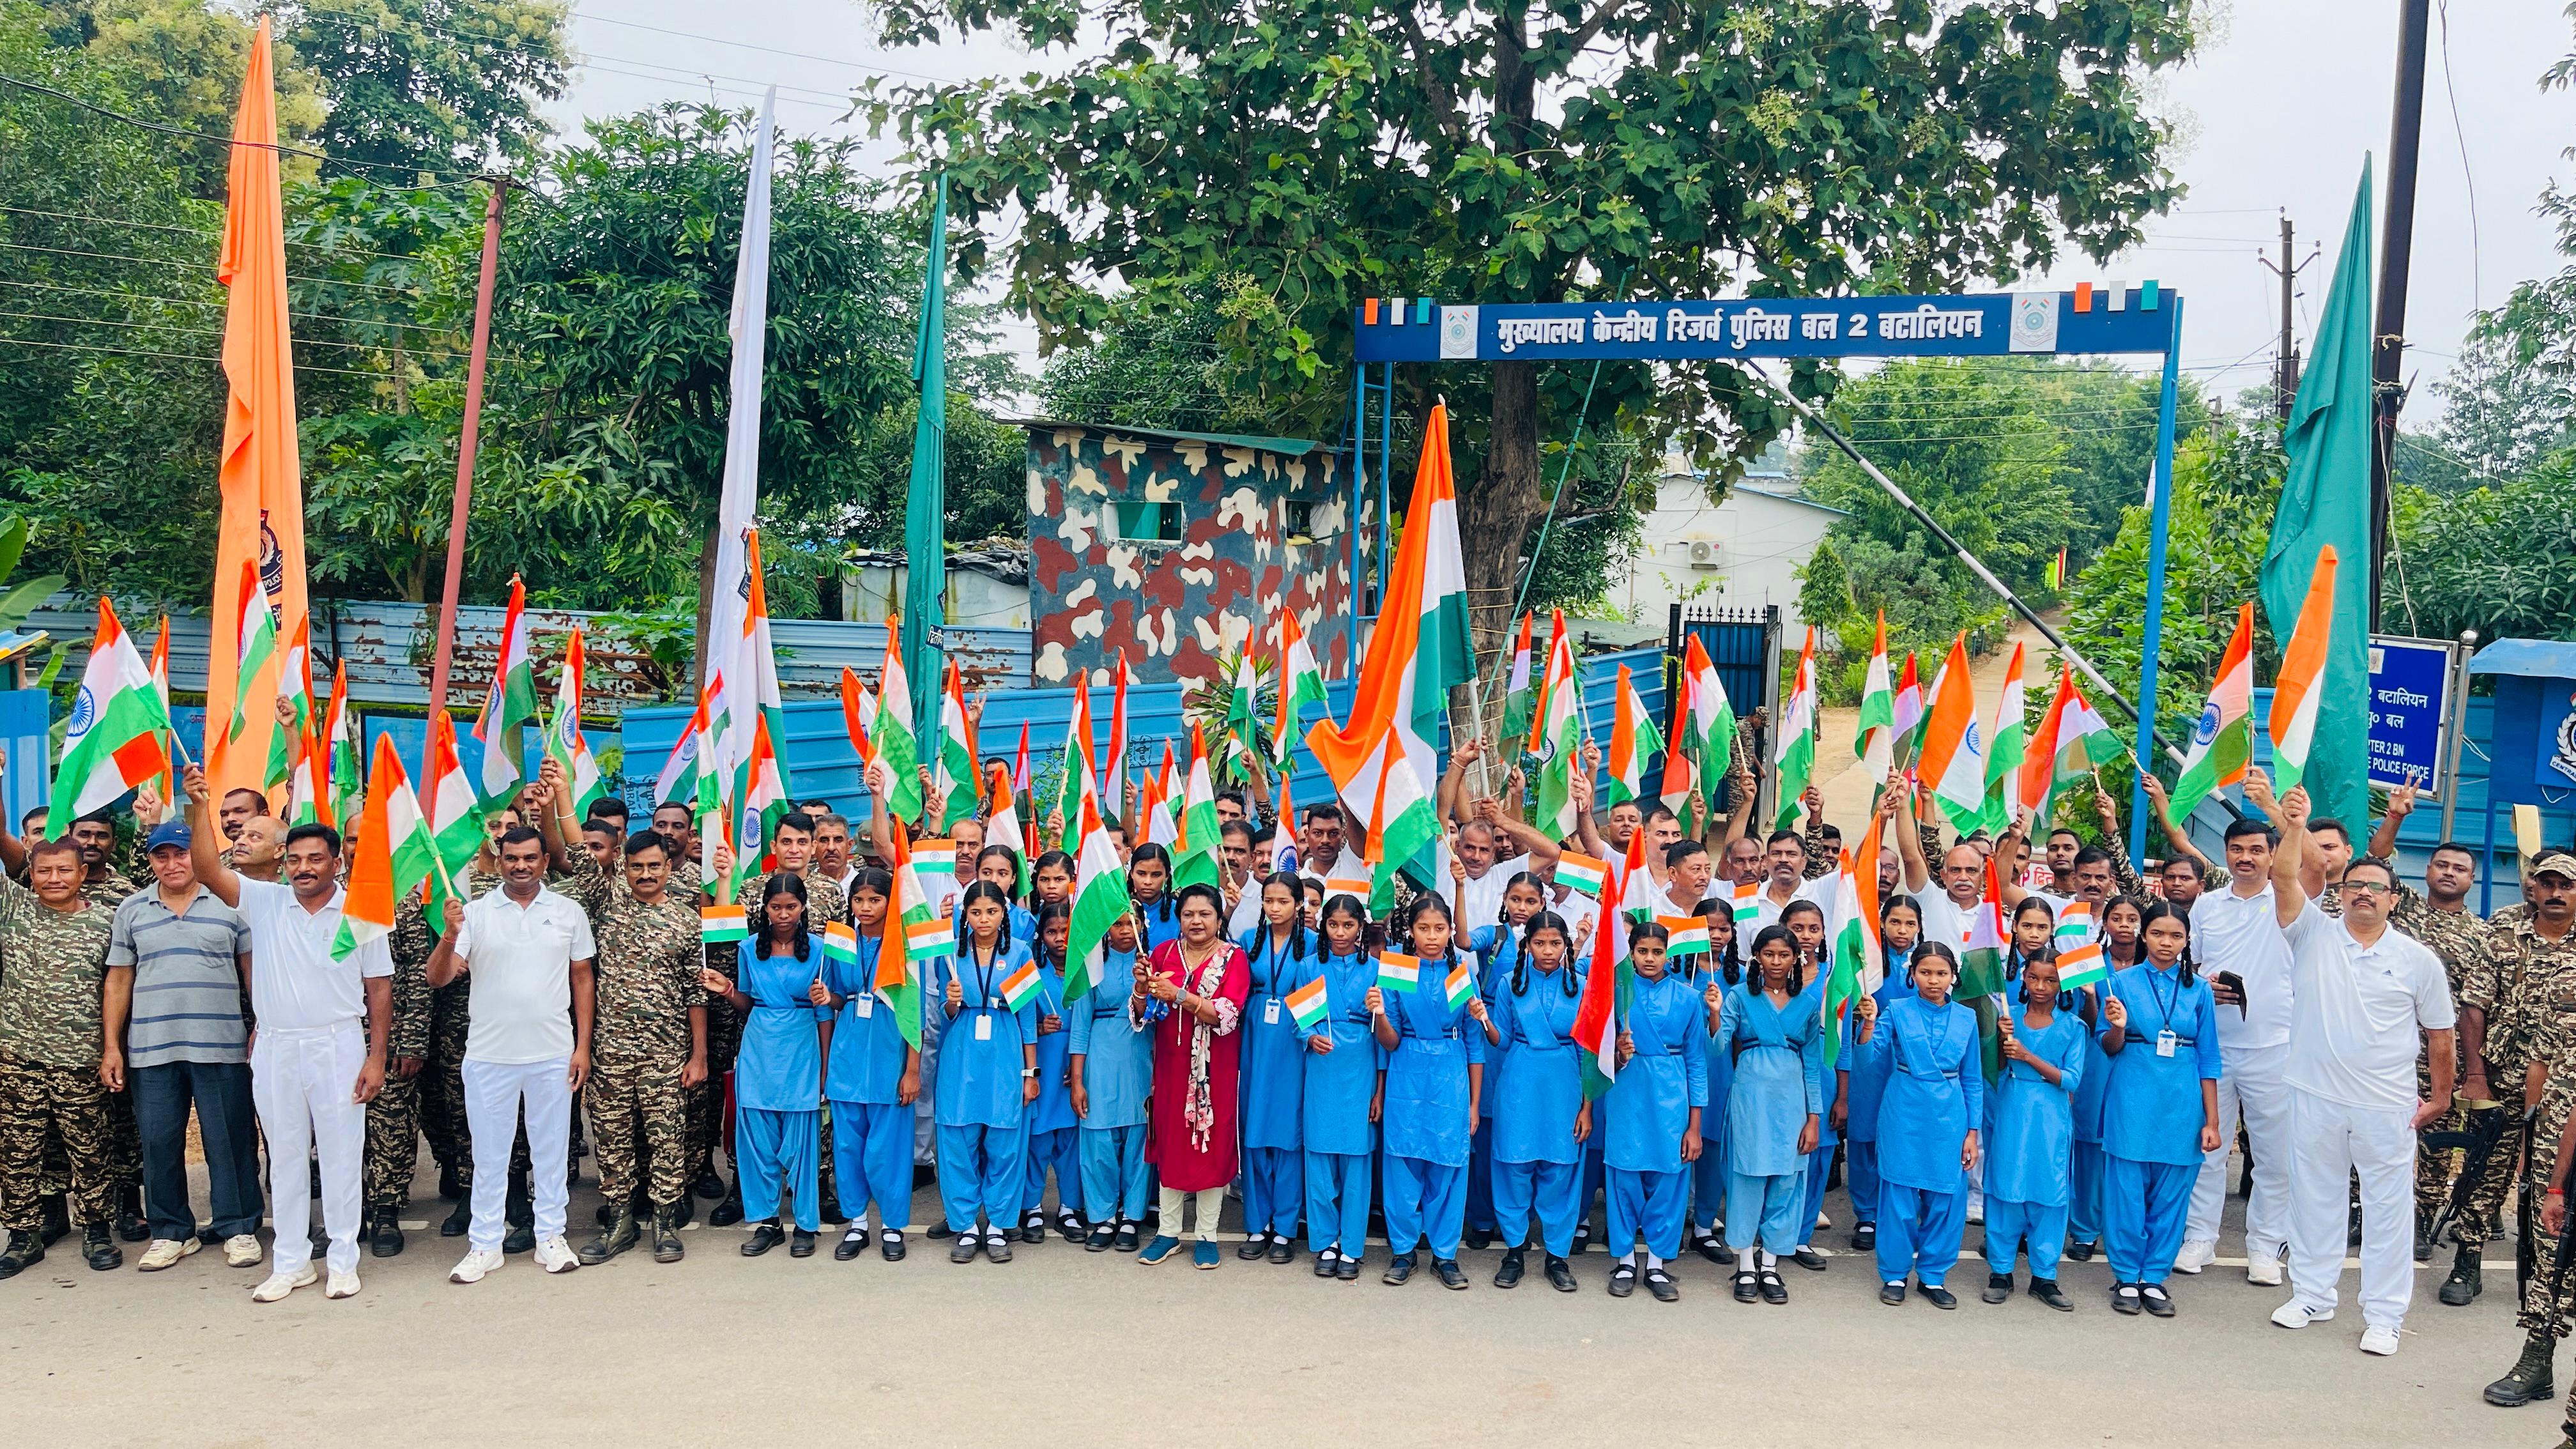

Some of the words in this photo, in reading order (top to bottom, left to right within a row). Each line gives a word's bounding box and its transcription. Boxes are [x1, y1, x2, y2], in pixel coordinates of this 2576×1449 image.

[1498, 318, 1586, 353] मुख्यालय
[1592, 309, 1659, 344] केन्द्रीय
[1666, 308, 1724, 341] रिजर्व
[1730, 307, 1792, 350] पुलिस
[1801, 313, 1839, 340] बल
[1847, 313, 1869, 337] 2
[1878, 303, 1984, 340] बटालियन
[2377, 687, 2428, 709] बटालियन
[2386, 714, 2405, 729] बल
[2386, 742, 2392, 755] 2
[2393, 743, 2405, 757] BN
[2372, 757, 2401, 775] POLICE
[2402, 762, 2430, 779] FORCE
